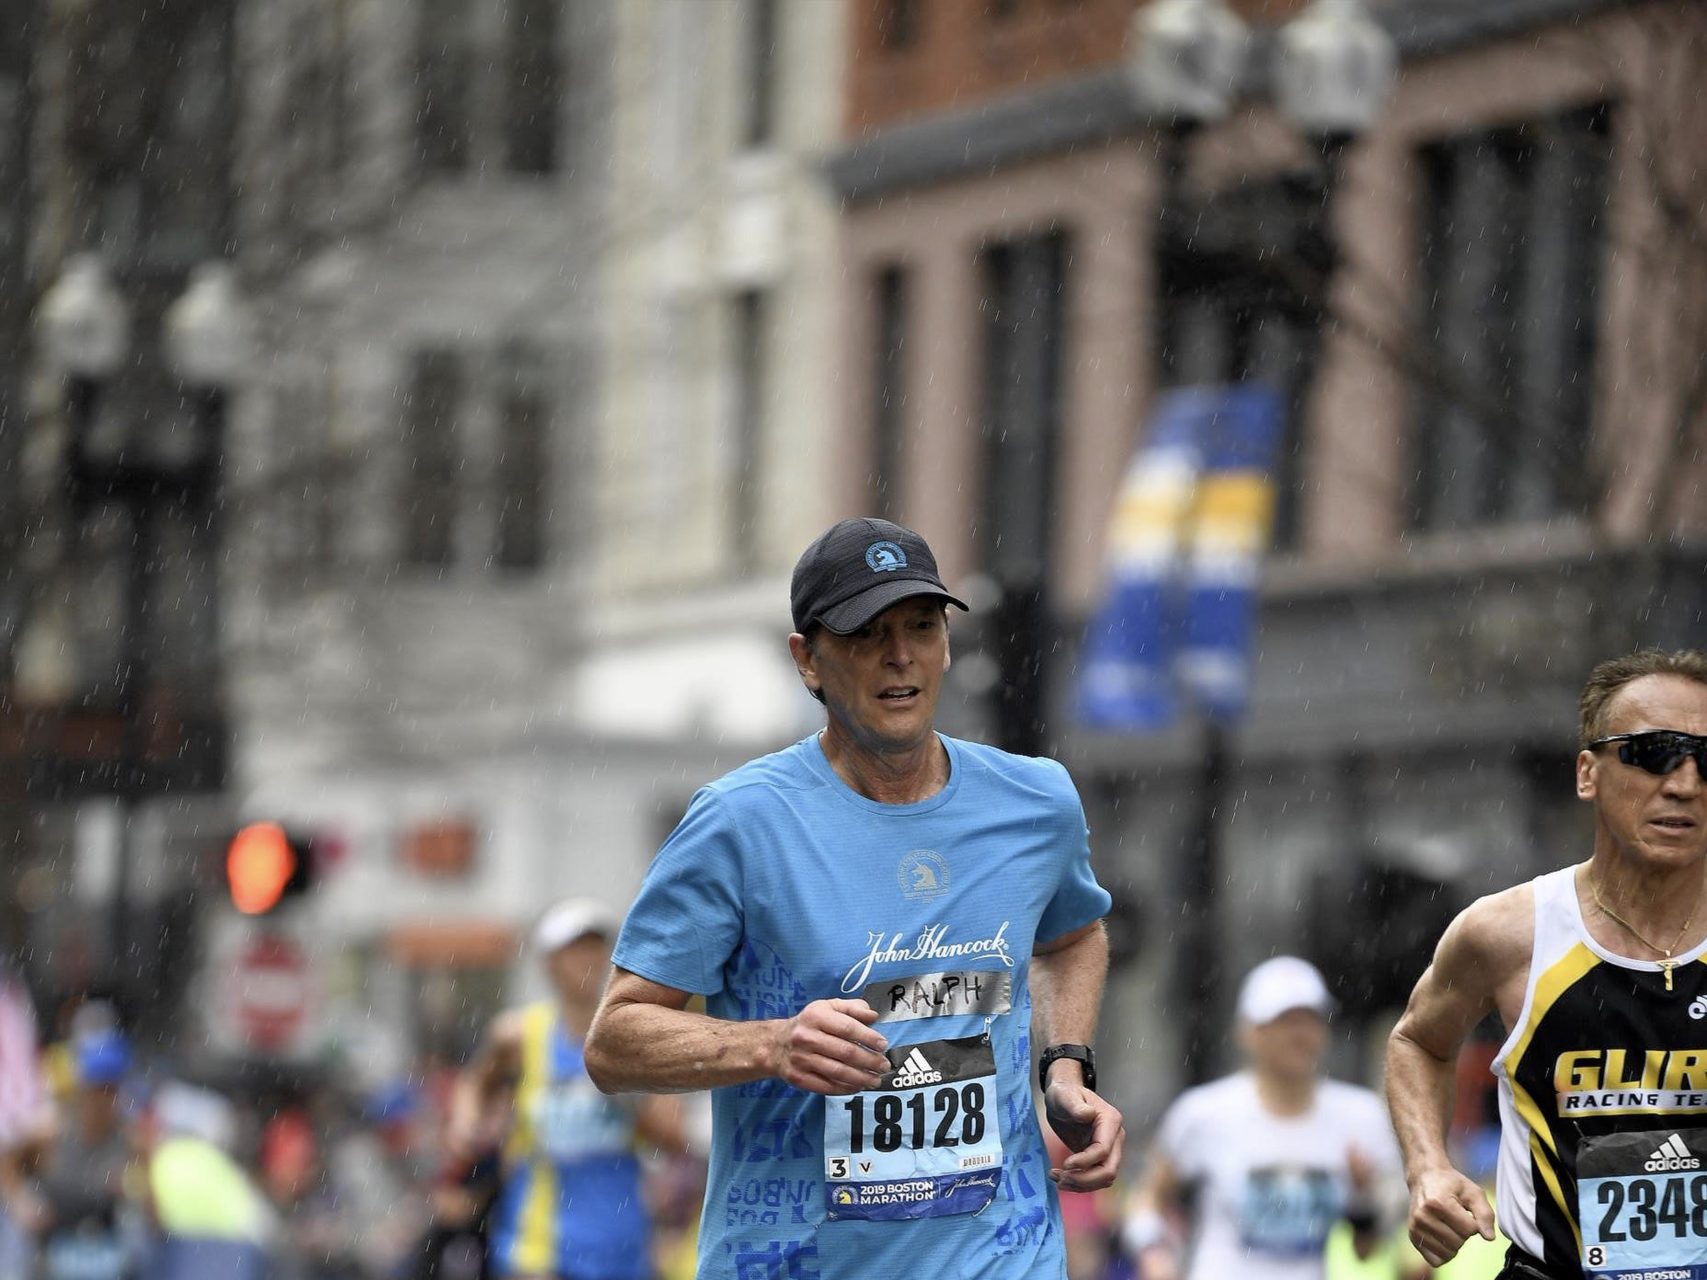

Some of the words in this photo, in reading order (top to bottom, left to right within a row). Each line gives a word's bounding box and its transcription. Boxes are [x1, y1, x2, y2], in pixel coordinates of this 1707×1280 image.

[841, 931, 910, 993] John
[909, 921, 1015, 967] Hancock
[887, 974, 983, 1014] RALPH
[892, 1070, 943, 1088] adidas
[1566, 1093, 1659, 1109] RACING
[1674, 1093, 1707, 1106] TE
[844, 1082, 986, 1154] 18128
[831, 1159, 847, 1178] 3
[1644, 1155, 1701, 1172] adidas
[860, 1185, 886, 1195] 2019
[887, 1181, 934, 1194] BOSTON
[860, 1191, 936, 1205] MARATHON
[1597, 1175, 1707, 1243] 2348
[1588, 1247, 1604, 1266] 8
